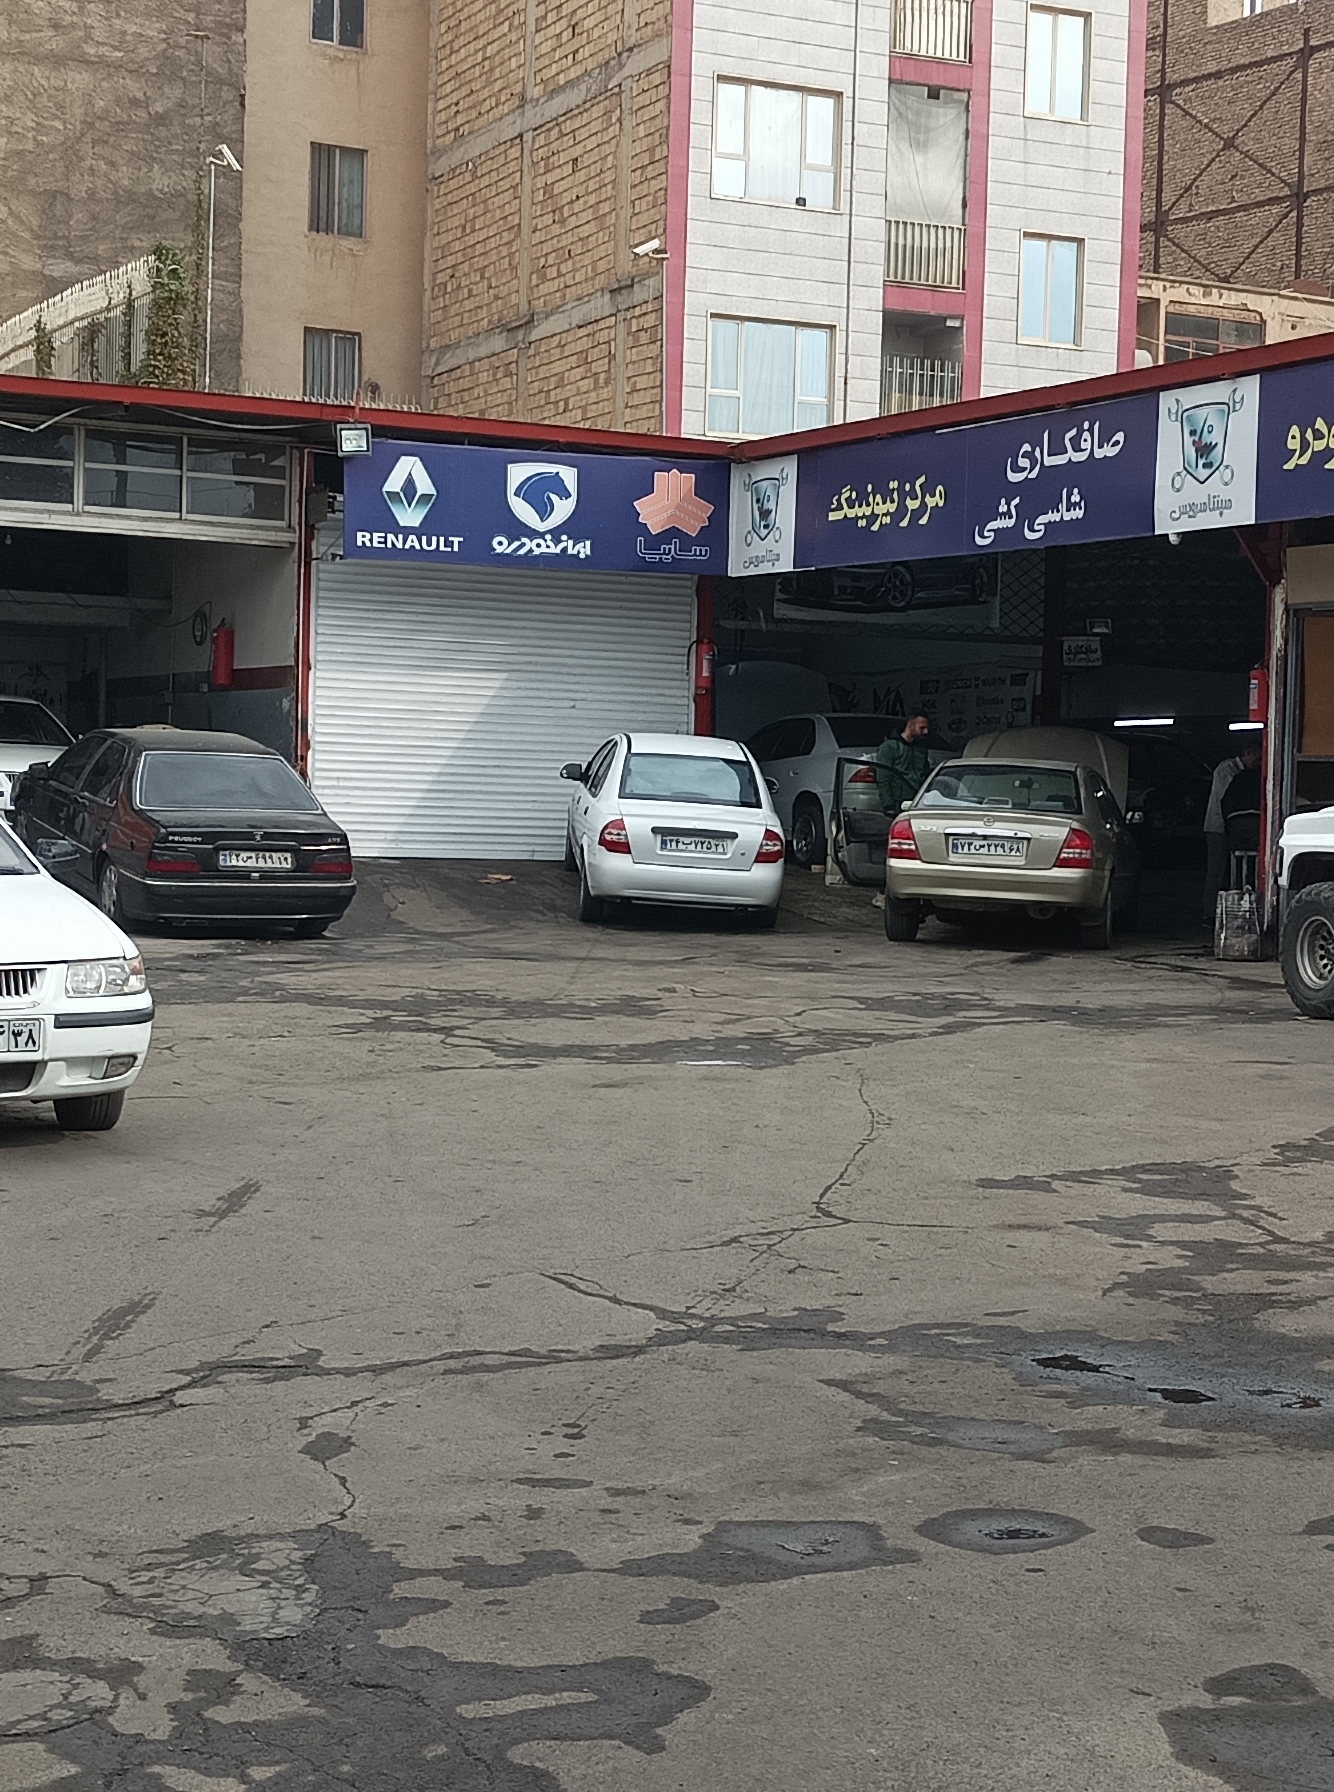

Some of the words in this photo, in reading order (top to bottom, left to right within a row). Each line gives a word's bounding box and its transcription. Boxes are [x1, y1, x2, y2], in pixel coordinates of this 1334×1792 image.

[1006, 420, 1125, 483] صافکاری
[828, 480, 899, 531] تیونینگ
[899, 474, 945, 526] مرکز
[974, 496, 1020, 546] کشی
[1023, 487, 1085, 540] شاسی
[356, 531, 464, 552] RENAULT
[637, 537, 710, 562] سایپا
